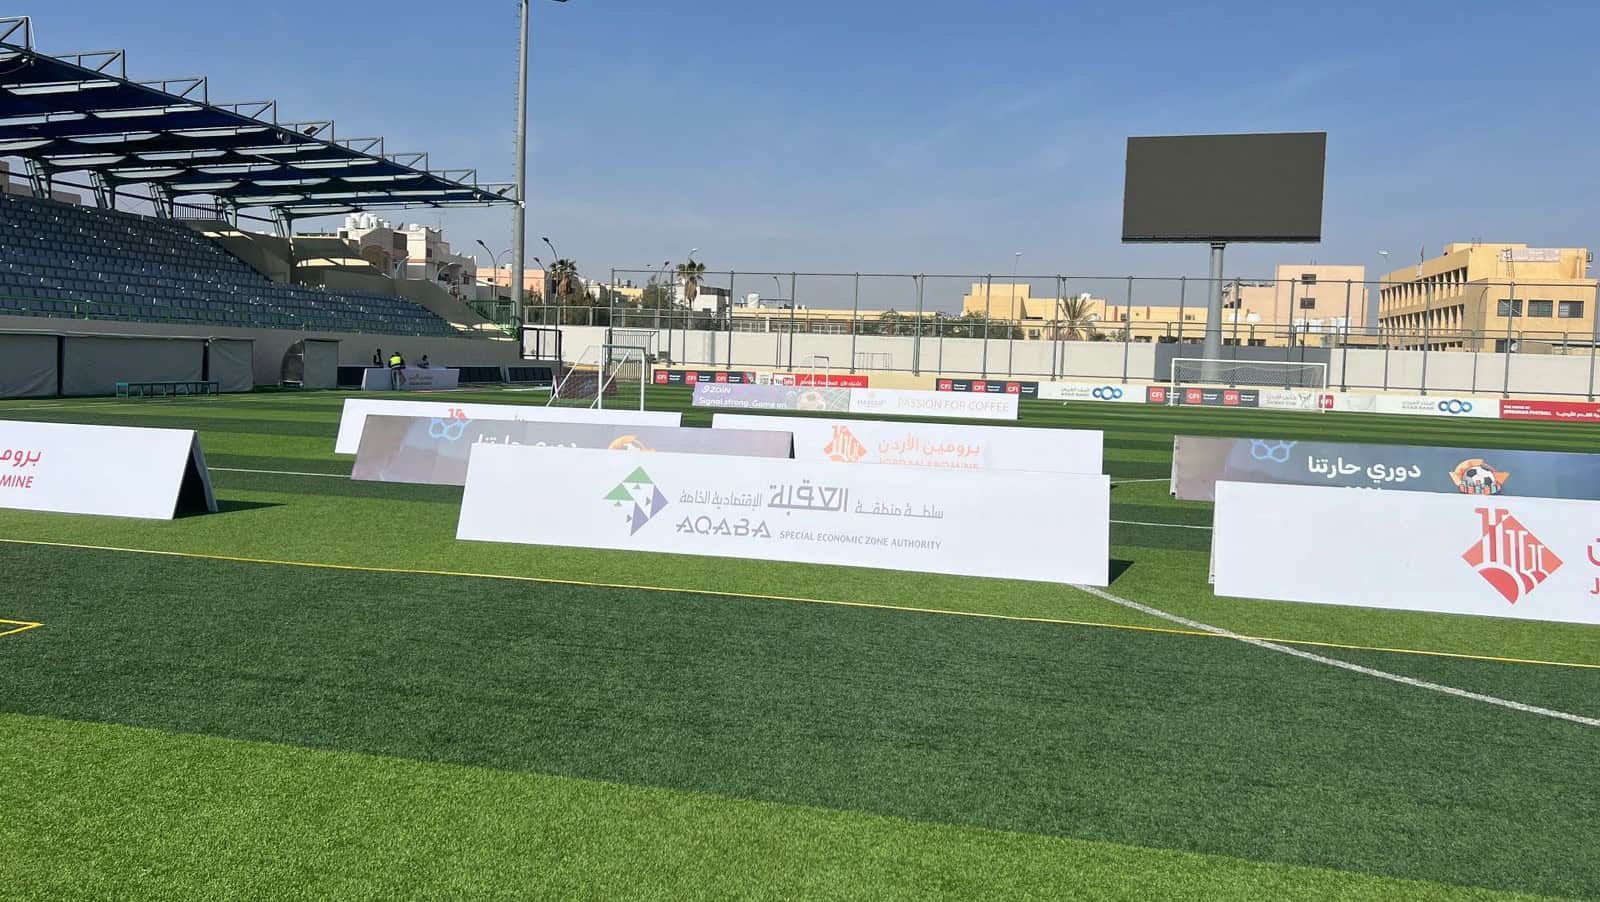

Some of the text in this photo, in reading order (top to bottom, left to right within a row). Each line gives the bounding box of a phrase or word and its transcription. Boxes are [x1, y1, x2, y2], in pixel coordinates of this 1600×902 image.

[945, 399, 967, 411] FOR
[968, 400, 1009, 412] COFFEE
[0, 449, 42, 467] بروم
[1308, 456, 1421, 483] دوري حارتنا
[0, 475, 34, 488] MINE
[768, 479, 849, 516] العقبة
[675, 515, 942, 550] AQABA SPECIAL ECONOMIC ZONE AUTHORITY
